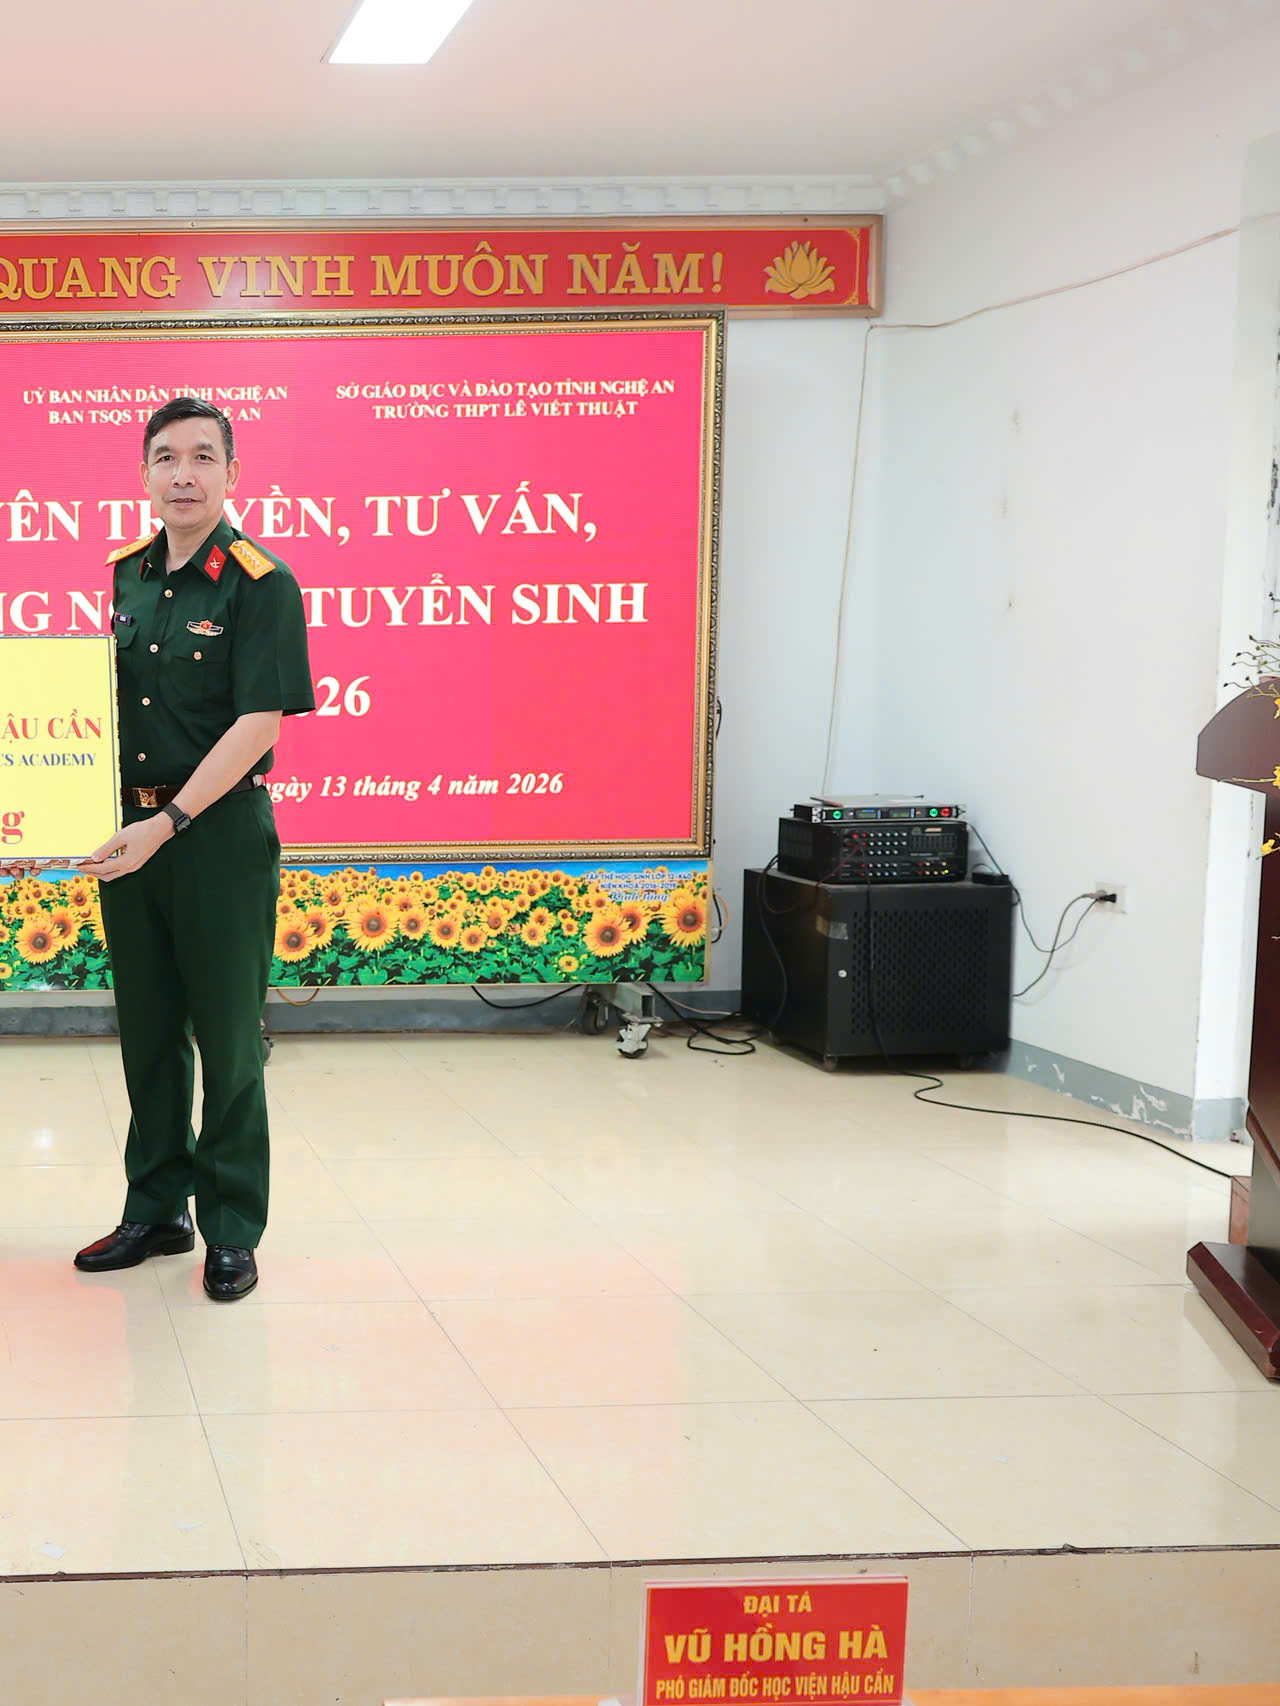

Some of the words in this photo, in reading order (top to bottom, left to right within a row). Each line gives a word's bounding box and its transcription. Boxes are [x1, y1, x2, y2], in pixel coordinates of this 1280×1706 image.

[196, 255, 356, 298] VINH
[370, 240, 549, 297] MUÔN
[566, 241, 725, 295] NĂM!
[49, 389, 82, 403] BAN
[85, 385, 132, 403] NHÂN
[135, 384, 170, 402] DÂN
[172, 384, 213, 401] TỈNH
[215, 384, 263, 403] NGHỆ
[264, 386, 288, 400] AN
[336, 381, 360, 399] SỞ
[362, 380, 407, 399] GIÁO
[410, 383, 445, 401] DỤC
[448, 379, 472, 397] VÀ
[475, 379, 513, 397] ĐÀO
[515, 381, 552, 399] TẠO
[554, 377, 597, 395] TỈNH
[600, 378, 649, 397] NGHỆ
[651, 379, 675, 395] AN
[48, 409, 84, 424] BAN
[87, 408, 132, 426] TSQS
[237, 407, 261, 422] AN
[372, 401, 449, 419] TRƯỜNG
[453, 403, 500, 418] THPT
[504, 399, 527, 417] LÊ
[530, 398, 573, 416] VIẾT
[576, 399, 638, 418] THUẬT
[365, 487, 452, 537] TƯ
[459, 479, 598, 543] VẤN,
[301, 572, 496, 628] TUYỂN
[511, 582, 649, 626] SINH
[47, 708, 103, 740] CẦN
[18, 752, 97, 767] ACADEMY
[319, 775, 347, 798] 13
[353, 774, 422, 802] tháng
[427, 774, 443, 796] 4
[448, 774, 499, 796] năm
[506, 773, 565, 795] 2026
[743, 1594, 780, 1618] ĐẠI
[786, 1591, 812, 1613] TÁ
[664, 1627, 712, 1664] VŨ
[723, 1622, 826, 1662] HỒNG
[838, 1623, 888, 1659] HÀ
[656, 1674, 685, 1699] PHÓ
[688, 1673, 726, 1698] GIÁM
[729, 1671, 758, 1697] ĐỐC
[762, 1675, 791, 1701] HỌC
[795, 1671, 829, 1700] VIỆN
[831, 1671, 860, 1699] HẬU
[864, 1667, 895, 1695] CẦN
